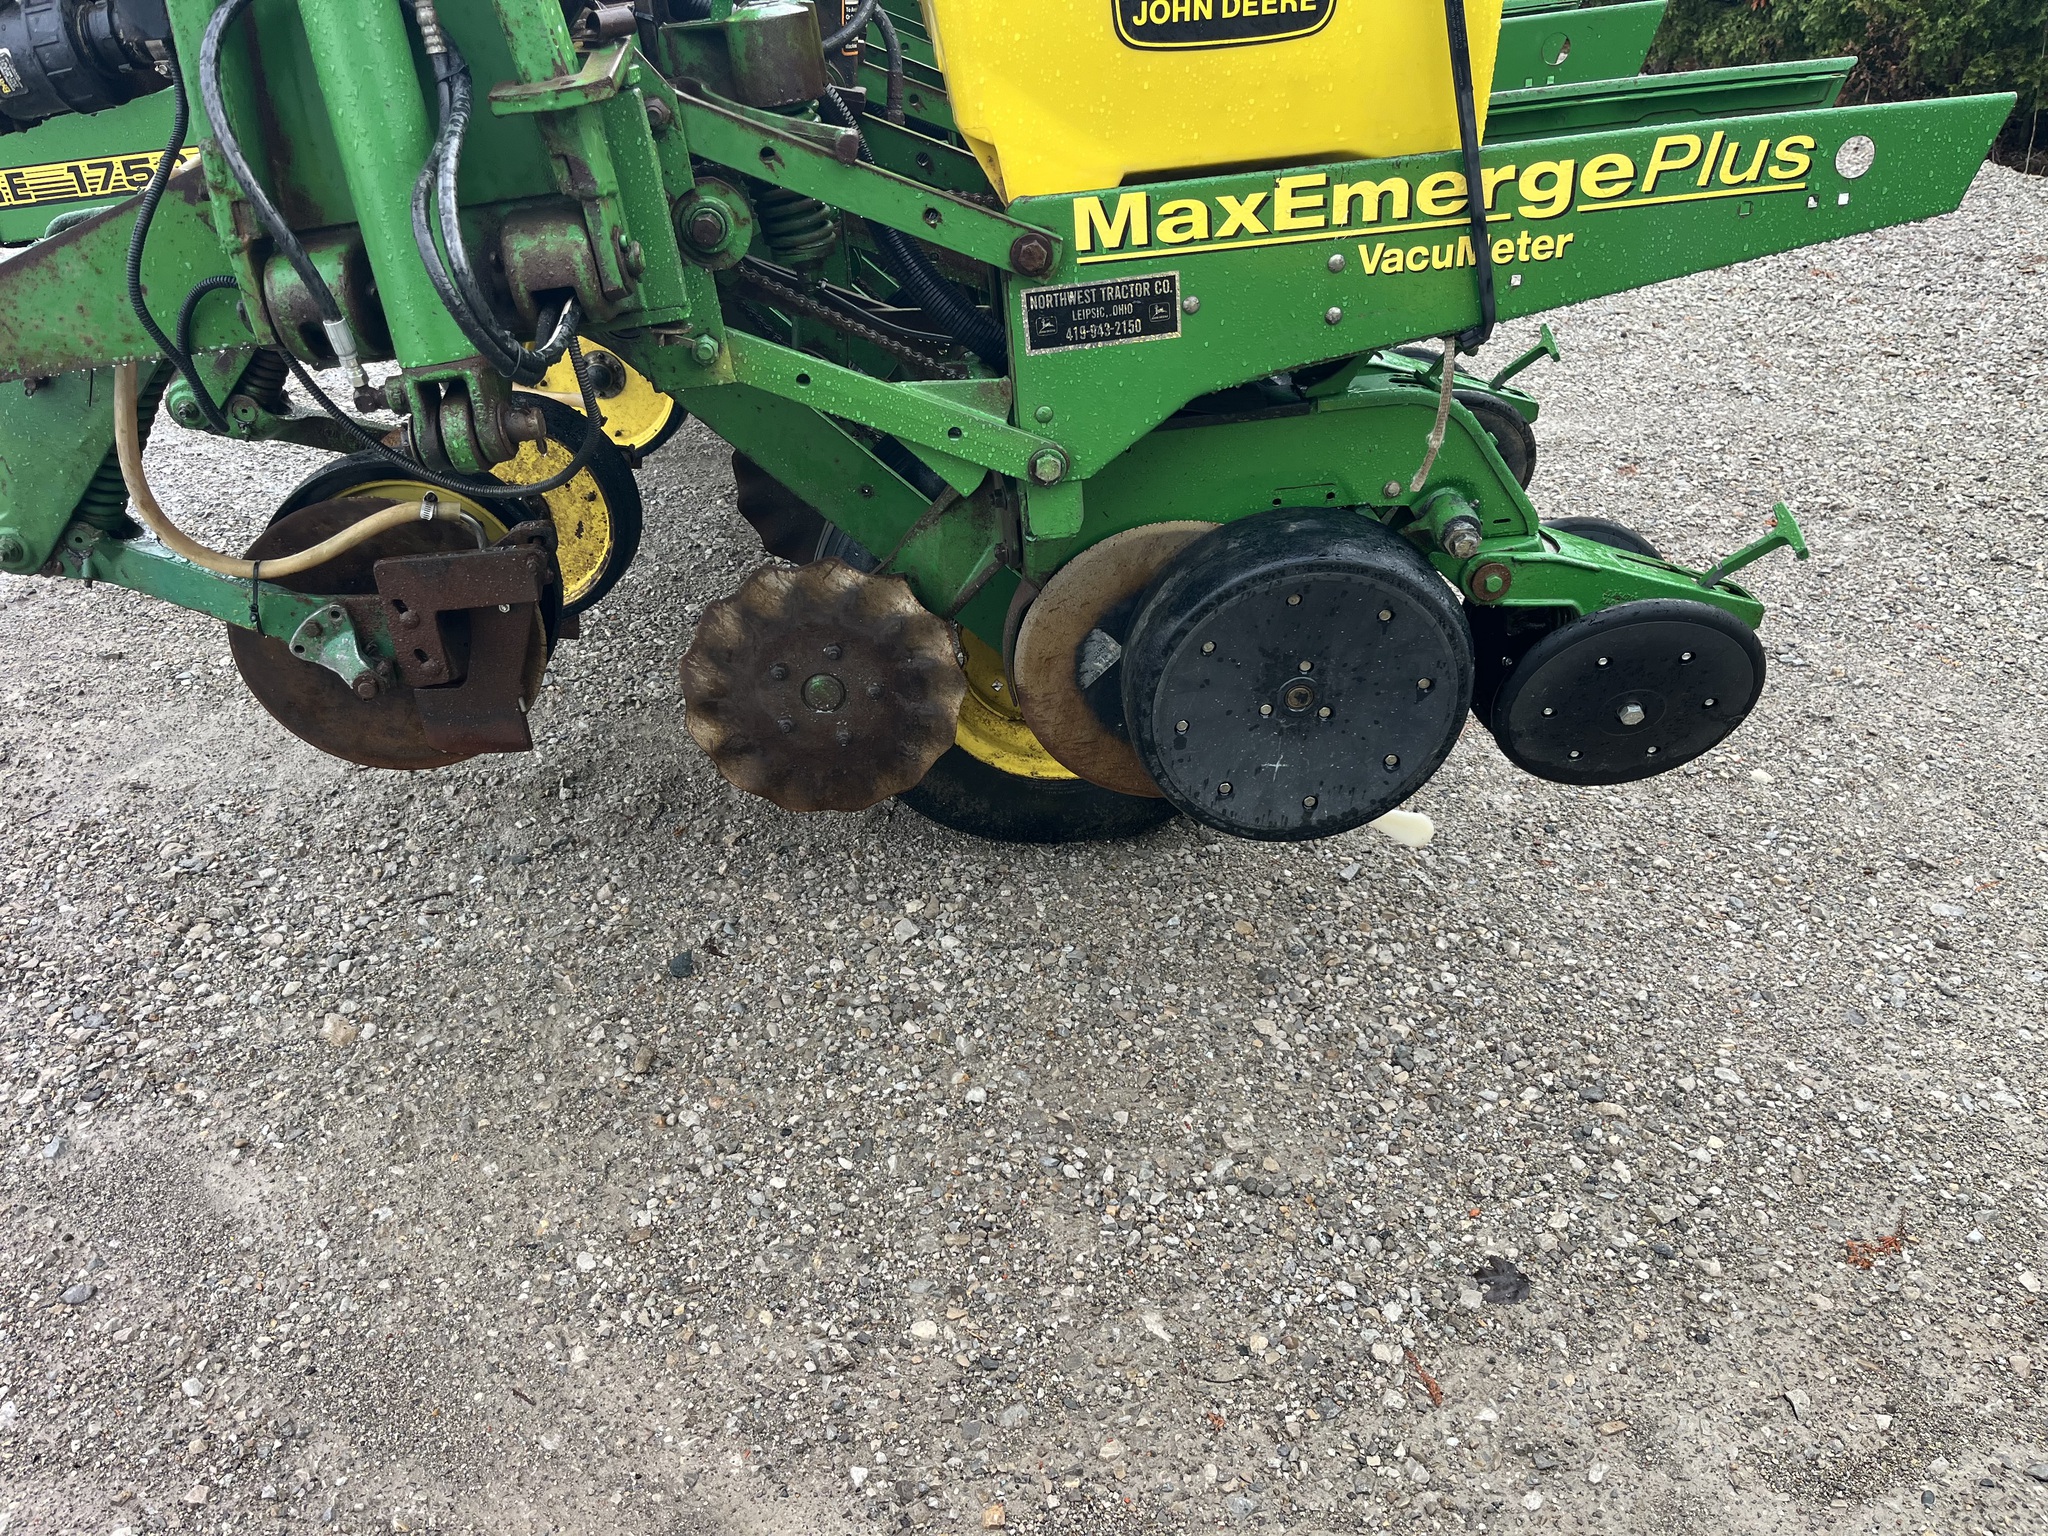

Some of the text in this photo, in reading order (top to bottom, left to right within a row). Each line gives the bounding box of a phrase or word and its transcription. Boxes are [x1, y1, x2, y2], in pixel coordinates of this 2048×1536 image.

[1132, 0, 1213, 26] JOHN
[1357, 230, 1574, 275] VacuMeter
[1029, 279, 1173, 310] NORTHWEST TRACTOR CO.
[1065, 318, 1142, 341] 419-943-2150
